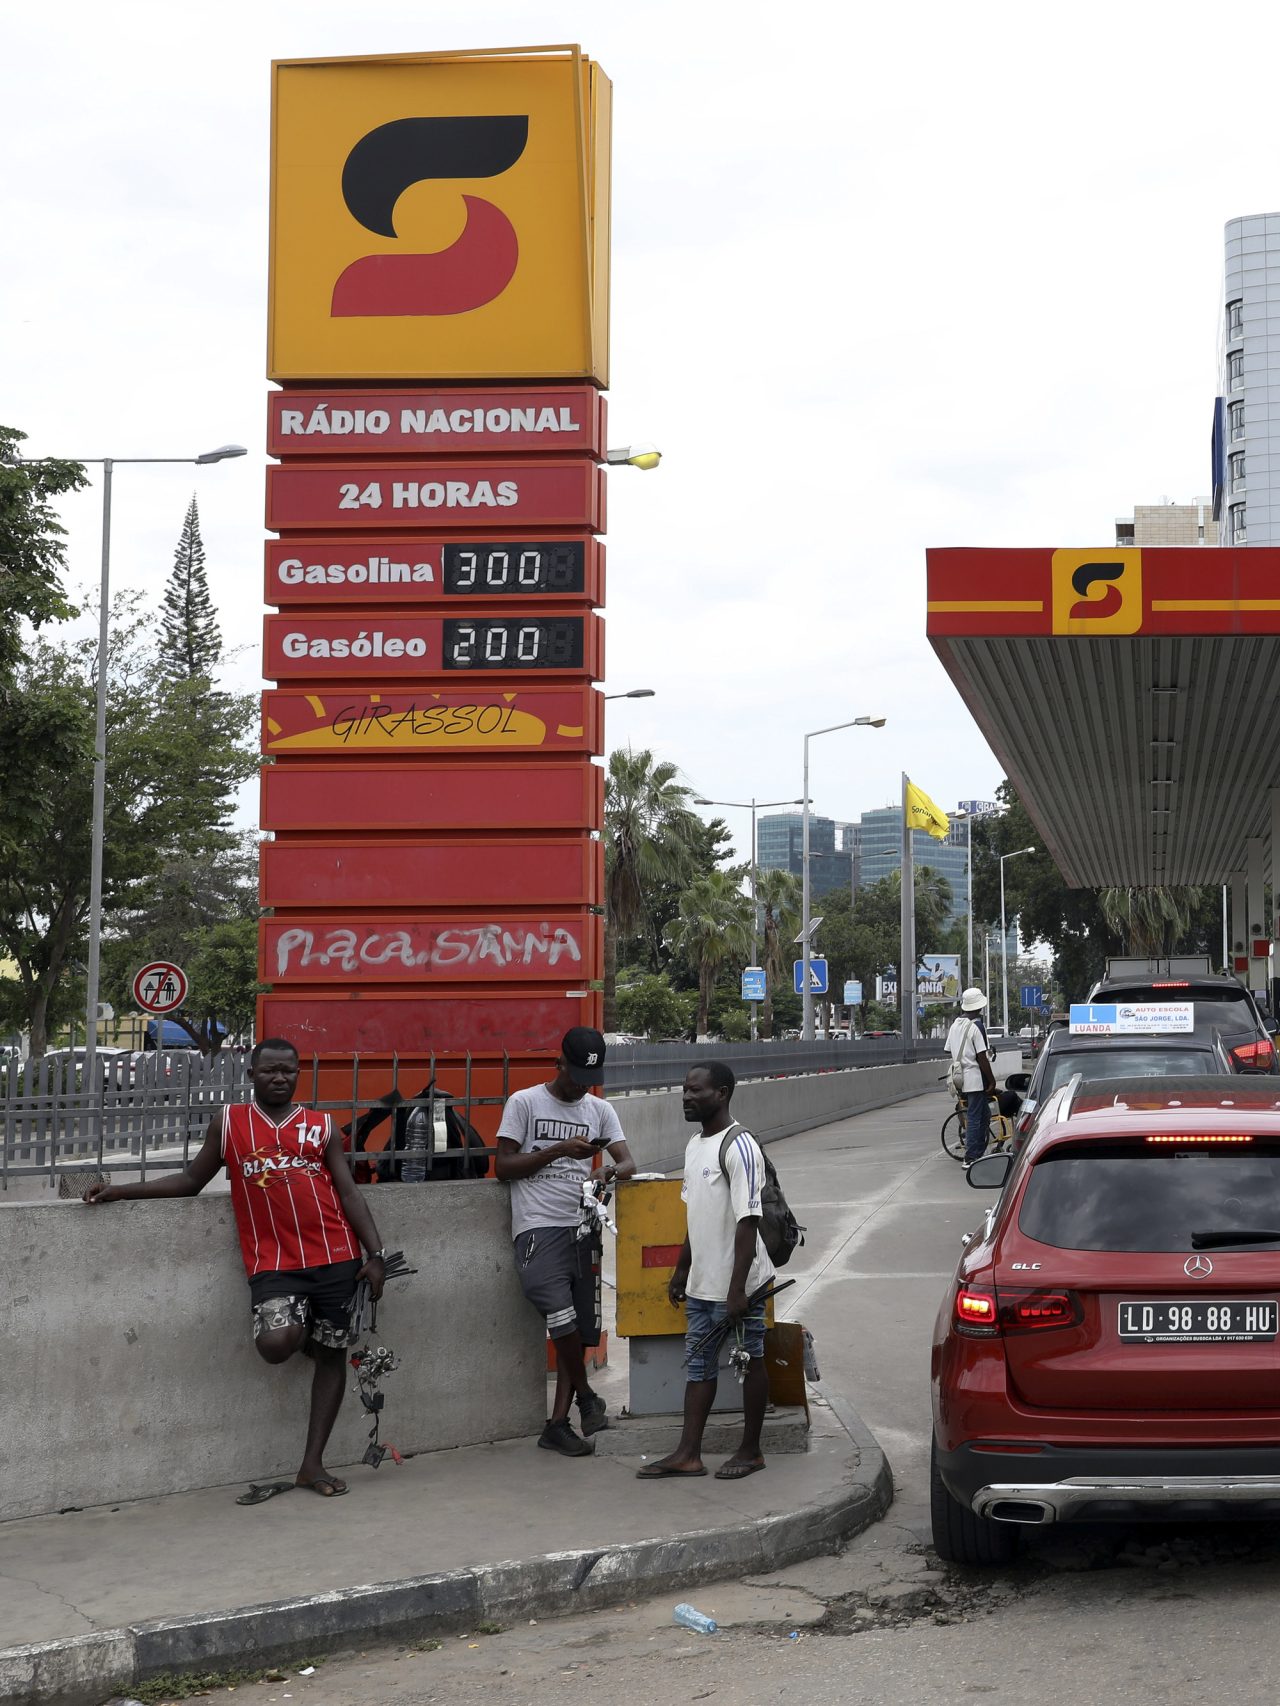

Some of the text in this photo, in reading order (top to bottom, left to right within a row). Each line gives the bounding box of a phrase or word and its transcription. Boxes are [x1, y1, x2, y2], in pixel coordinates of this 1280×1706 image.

[281, 403, 580, 435] RÁDIO NACIONAL
[338, 481, 519, 509] 24 HORAS
[278, 551, 542, 586] Gasolina 300
[282, 627, 540, 661] Gasóleo 200
[331, 703, 518, 743] GIRASSOL
[1089, 1007, 1098, 1022] L
[1074, 1025, 1112, 1033] LUANDA
[295, 1122, 322, 1148] 14
[1011, 1262, 1042, 1270] GLC
